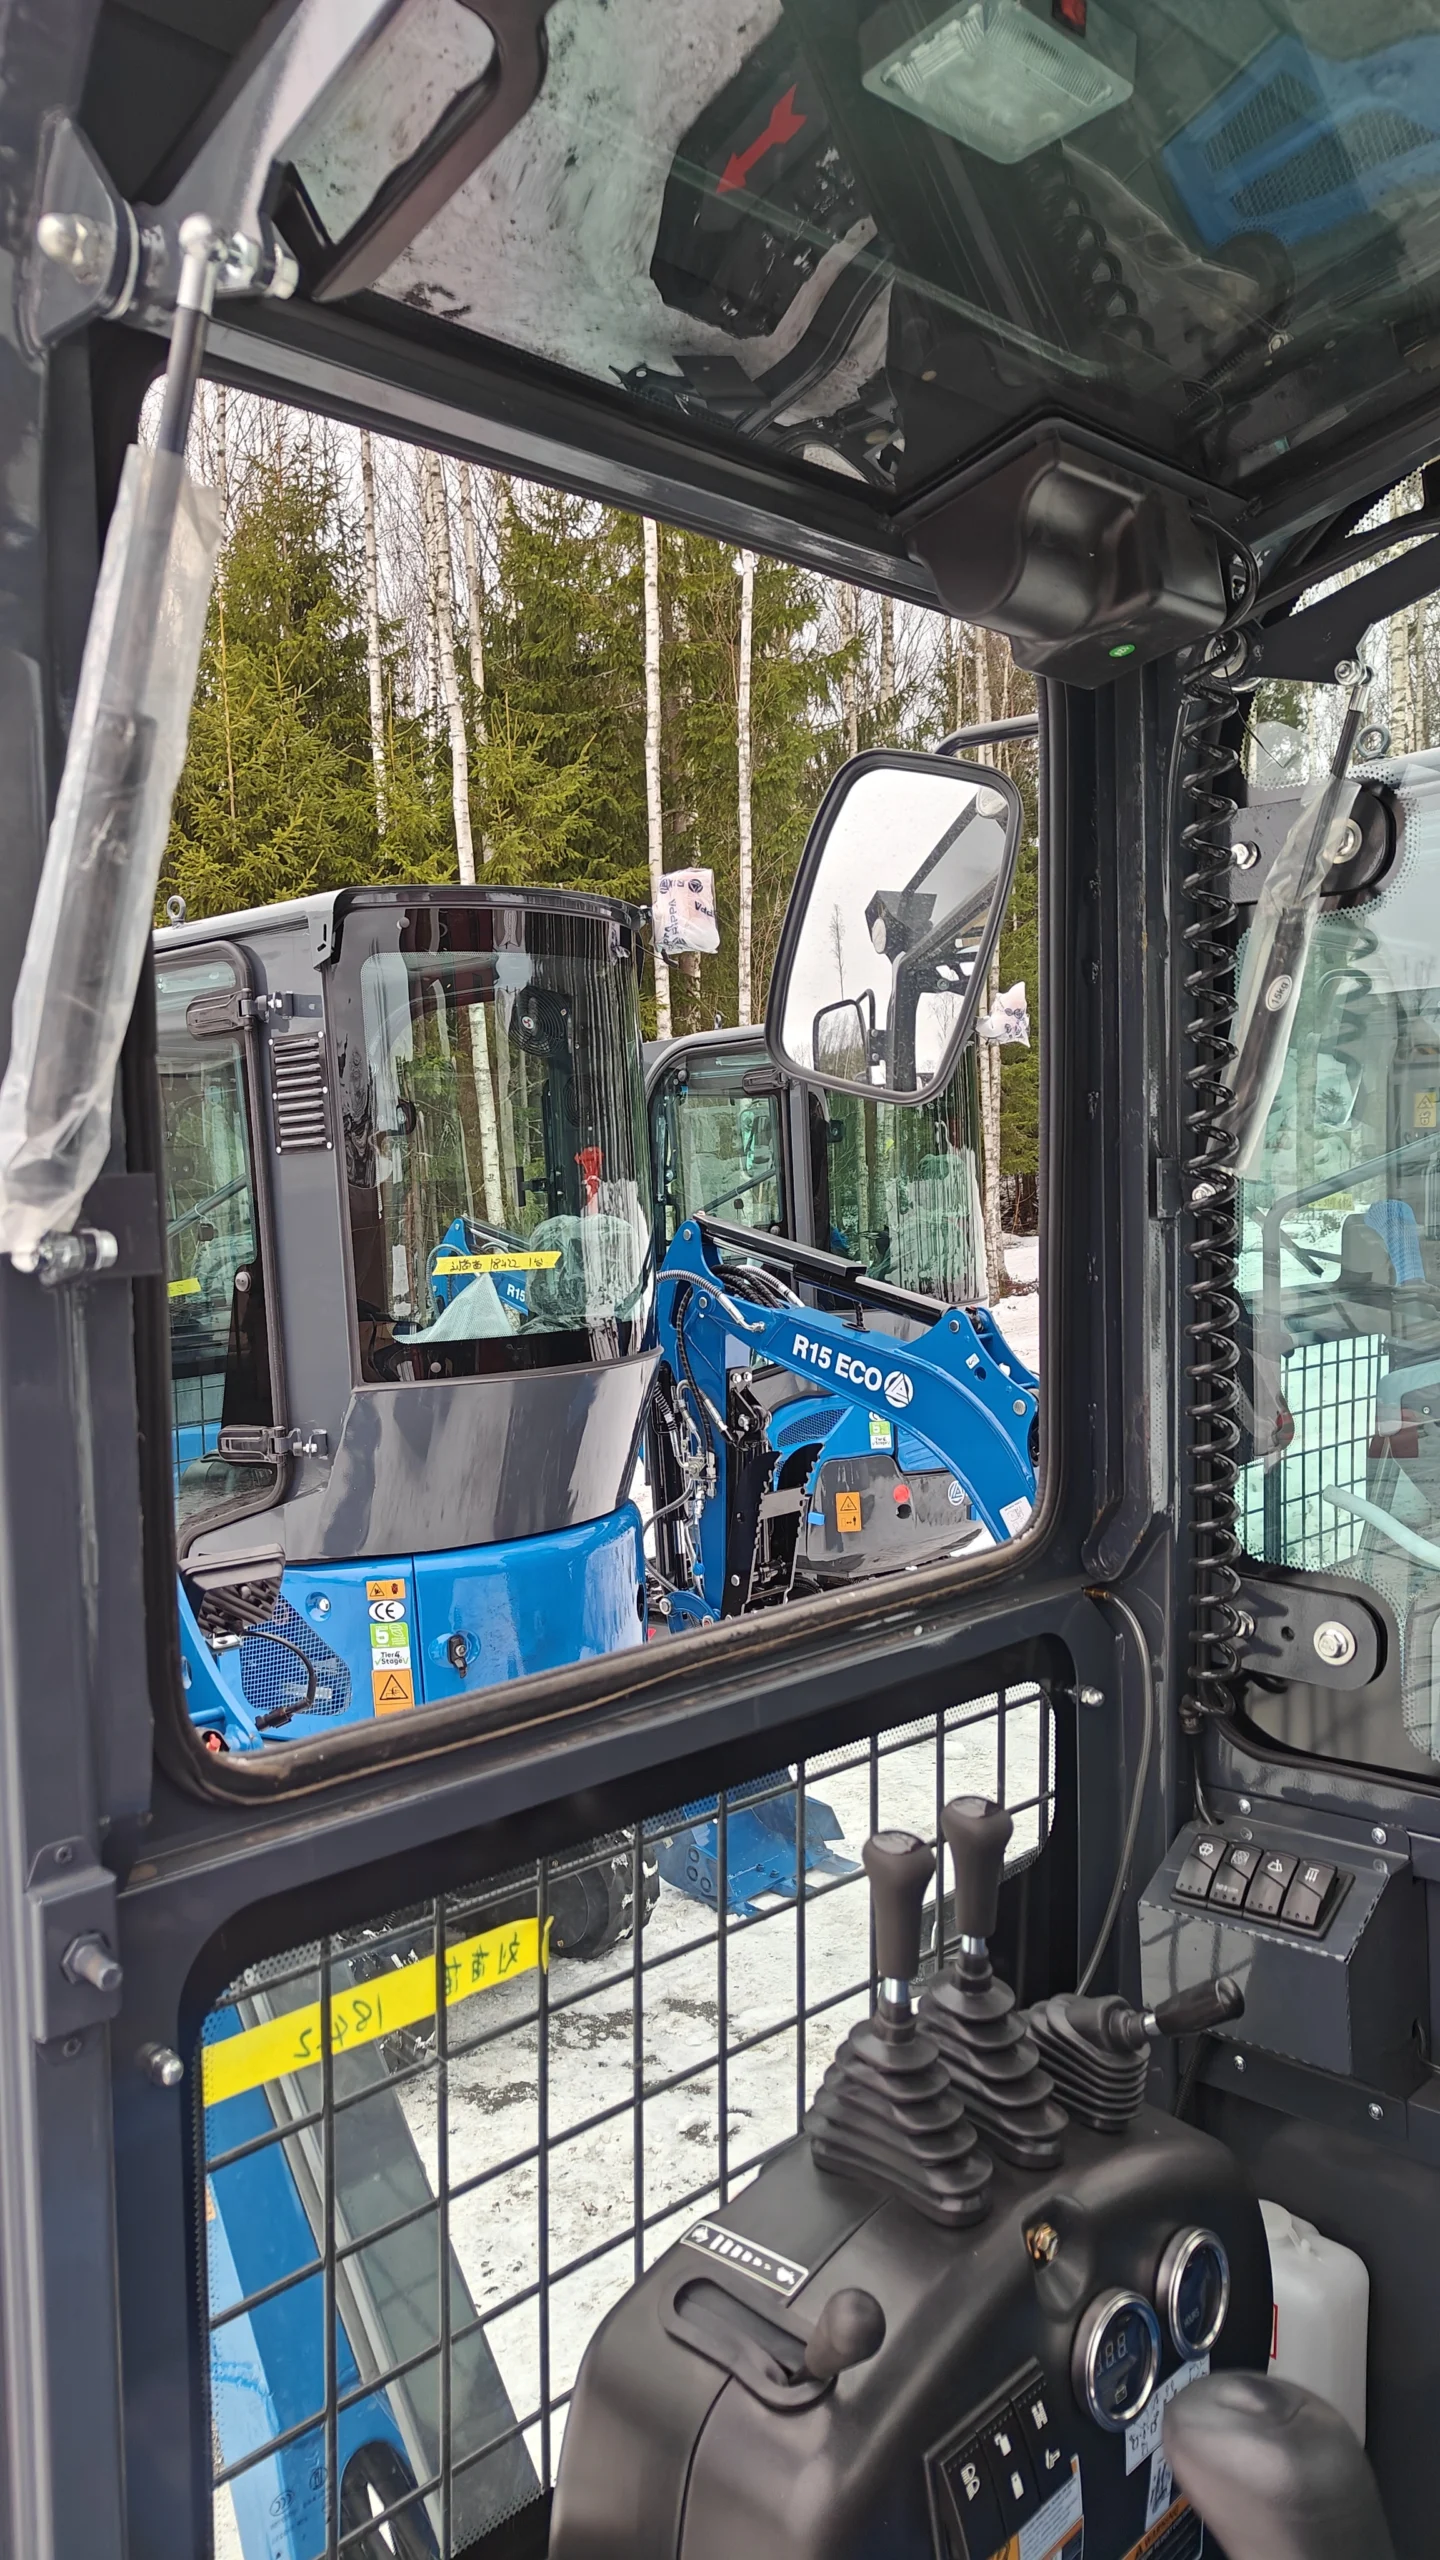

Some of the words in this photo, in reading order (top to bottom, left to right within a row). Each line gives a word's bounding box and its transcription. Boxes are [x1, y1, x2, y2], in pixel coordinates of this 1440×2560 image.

[1271, 981, 1289, 1005] 15kg
[506, 1283, 526, 1303] R15
[792, 1333, 833, 1369] R15
[834, 1352, 883, 1391] ECO
[375, 1602, 396, 1620] CE
